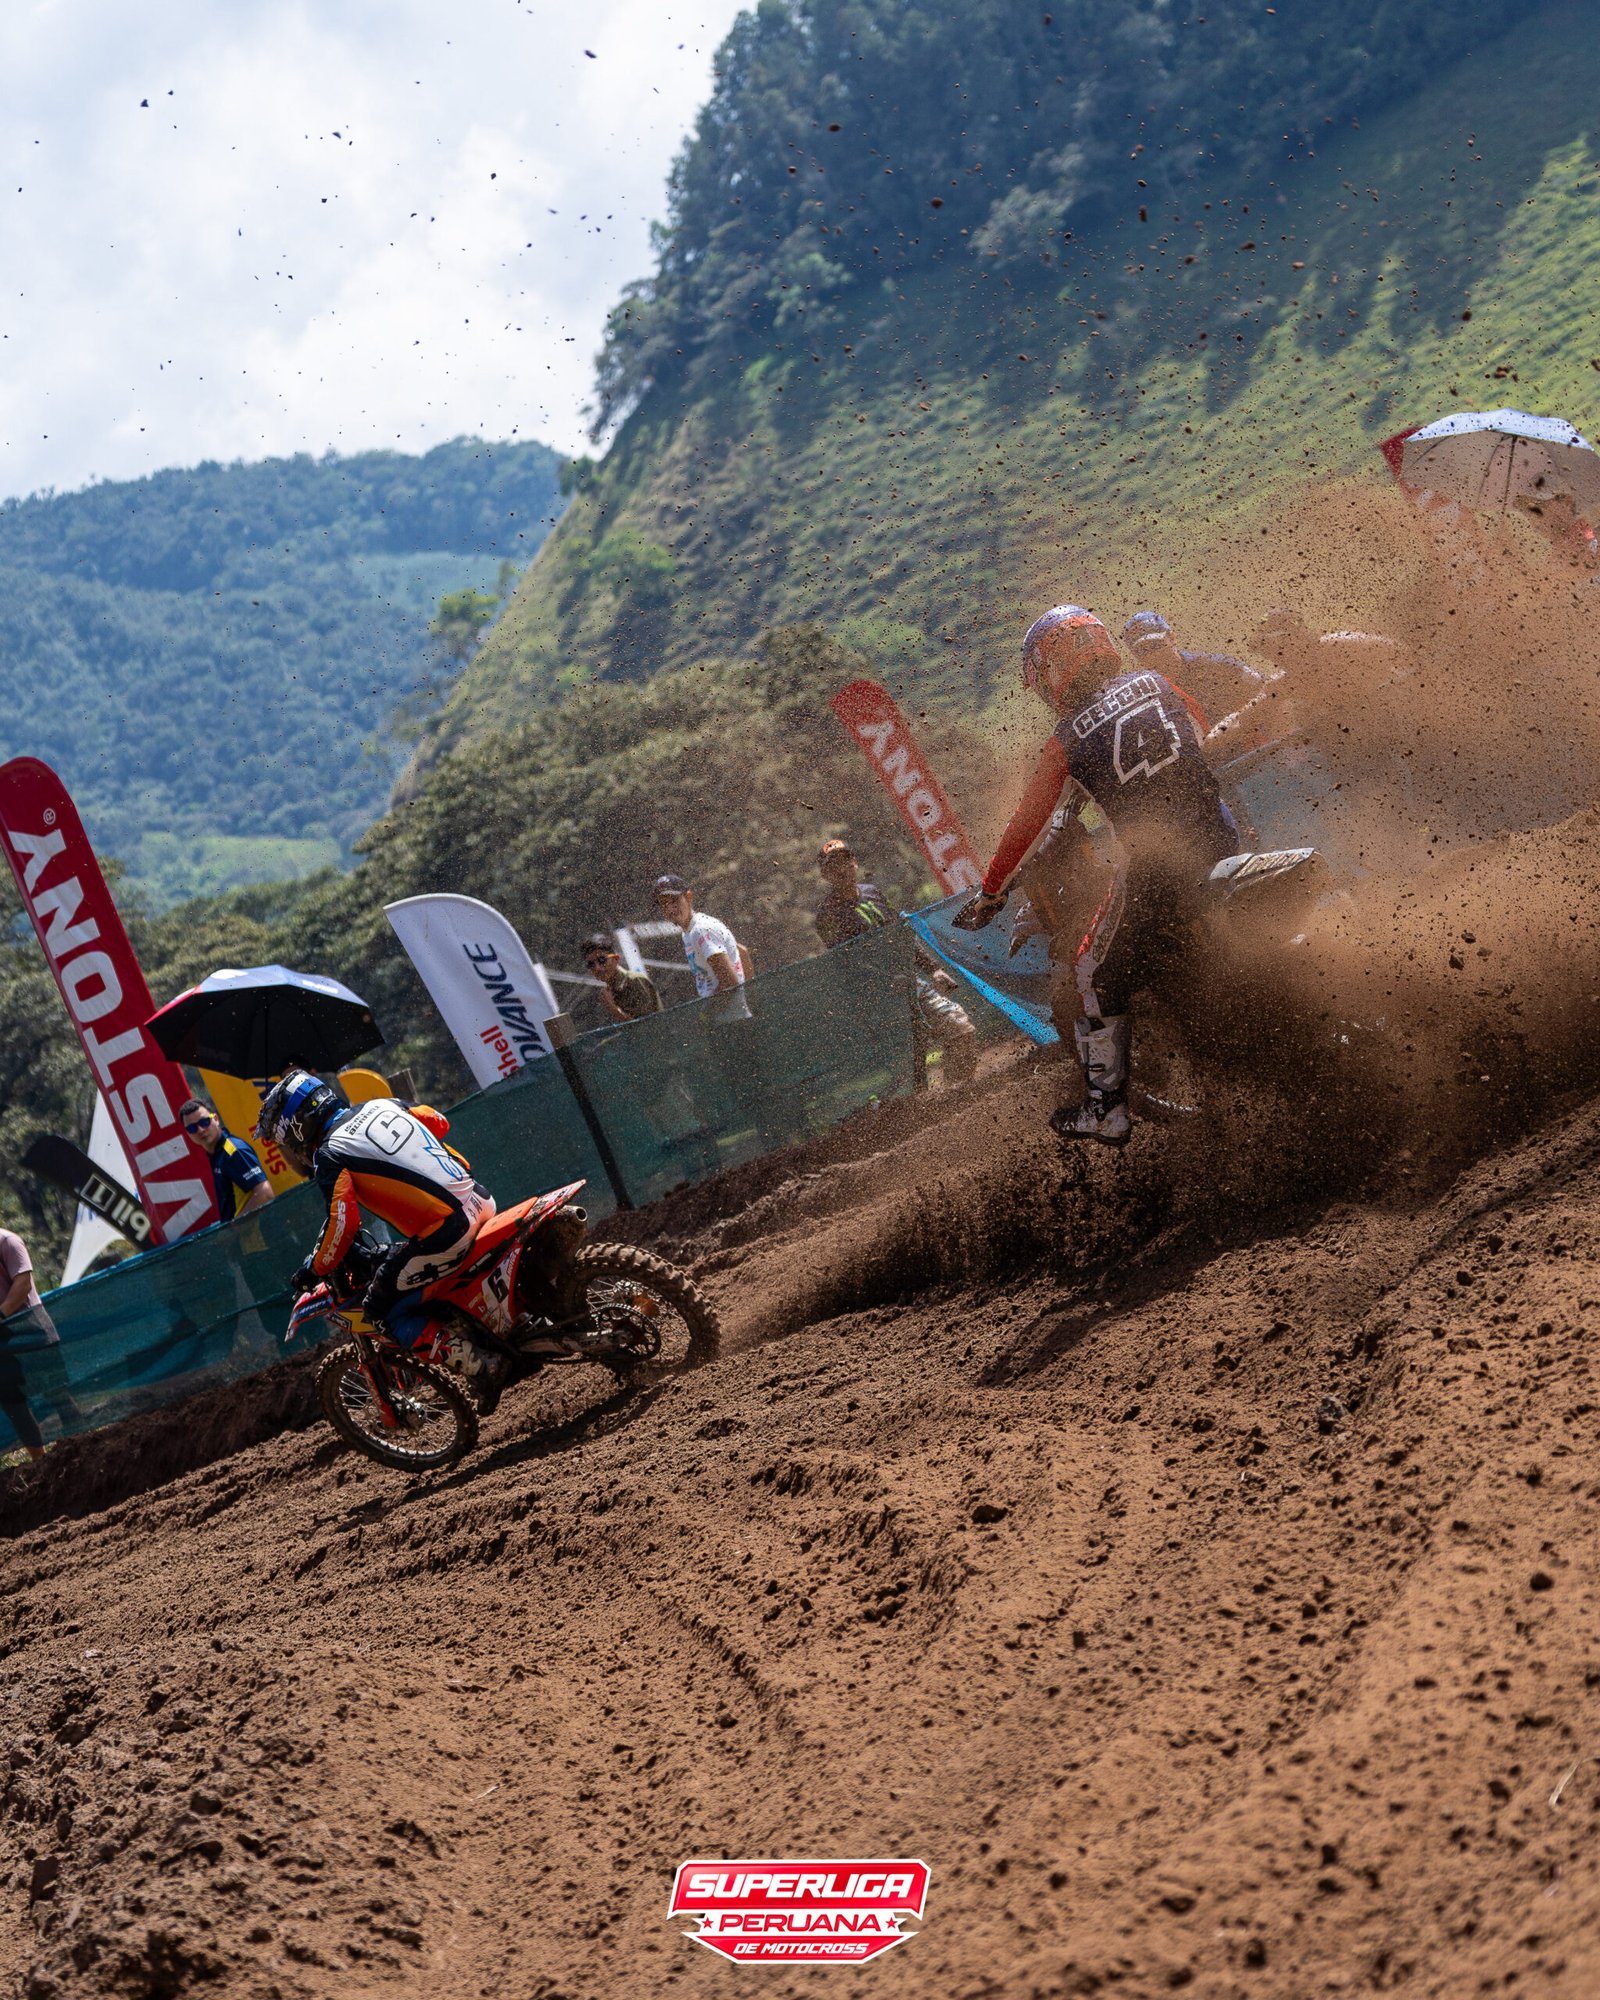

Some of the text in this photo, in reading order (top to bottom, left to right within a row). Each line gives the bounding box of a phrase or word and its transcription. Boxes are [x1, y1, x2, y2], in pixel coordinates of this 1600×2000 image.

[857, 719, 985, 893] STONY
[1113, 697, 1182, 785] 4
[8, 828, 212, 1244] VISTONY
[462, 942, 546, 1063] DVANCE
